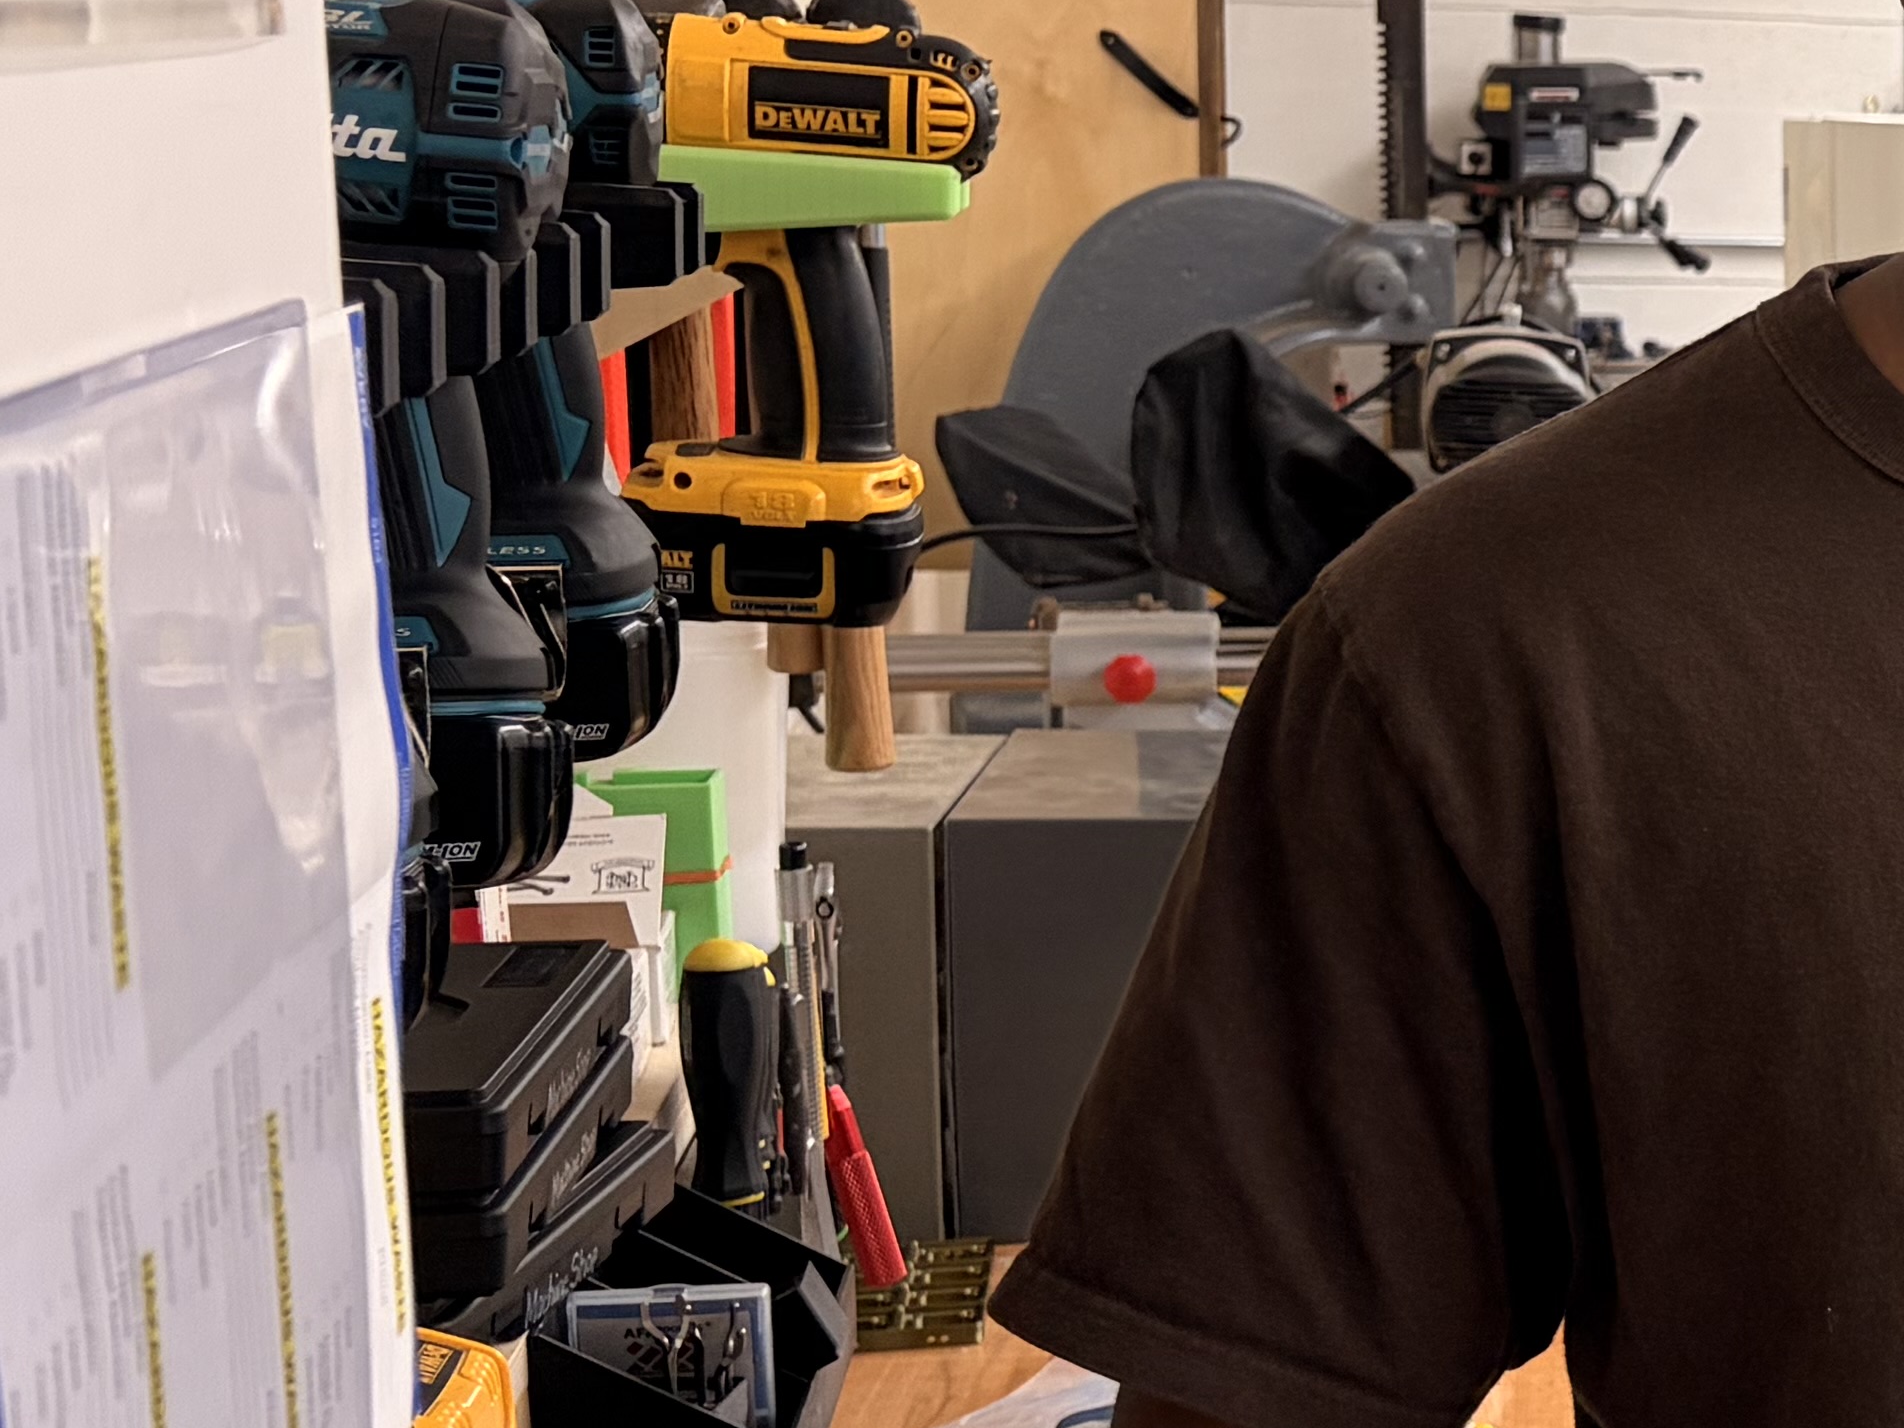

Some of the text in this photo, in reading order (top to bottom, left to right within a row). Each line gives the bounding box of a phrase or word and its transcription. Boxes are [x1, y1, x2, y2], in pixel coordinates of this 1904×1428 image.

[487, 543, 547, 556] LESS
[661, 550, 694, 570] ALT
[574, 724, 609, 740] ION
[423, 841, 482, 862] -ION
[371, 996, 396, 1209] HAZARDOUS
